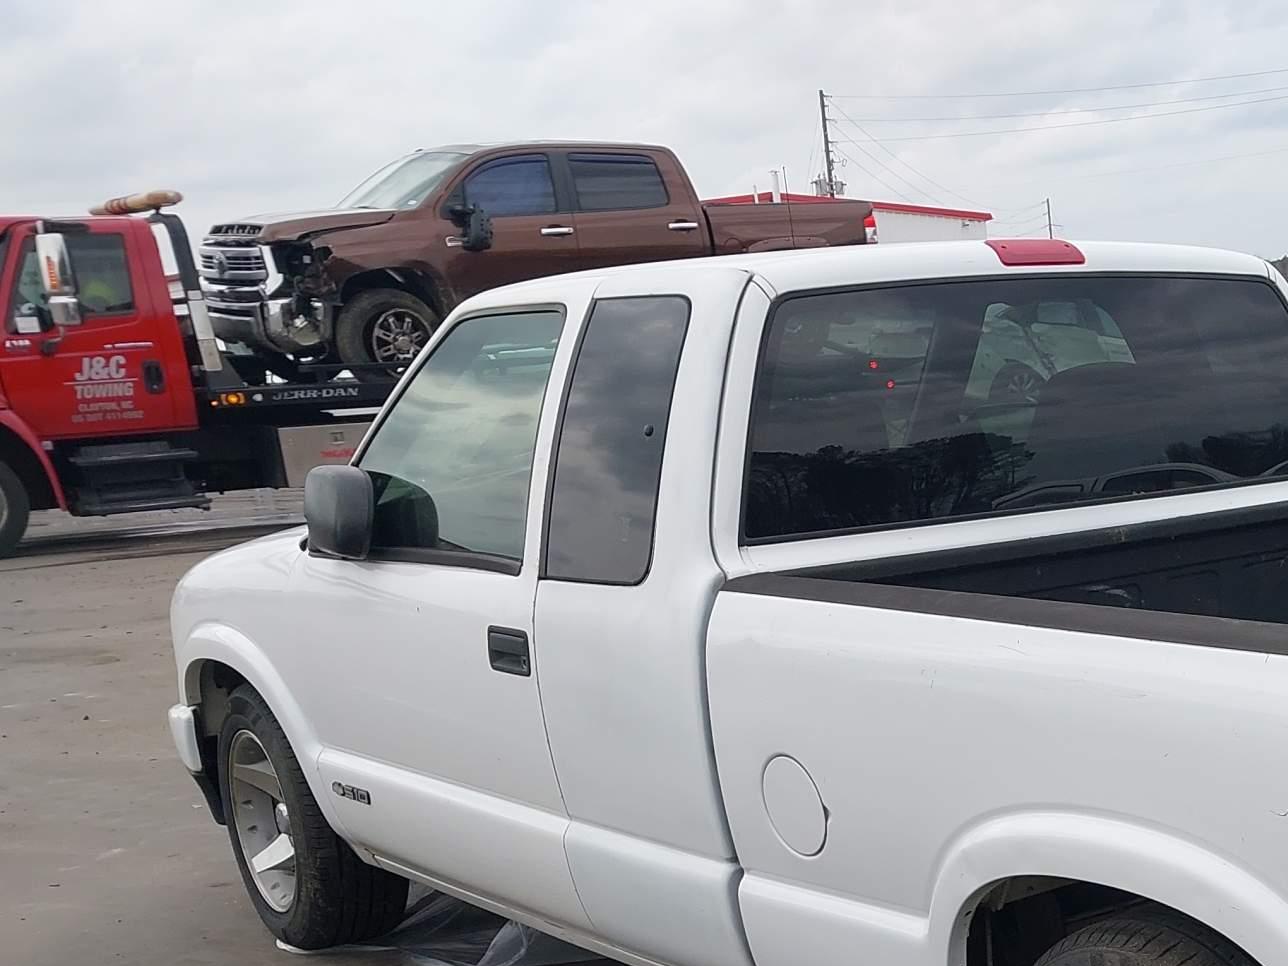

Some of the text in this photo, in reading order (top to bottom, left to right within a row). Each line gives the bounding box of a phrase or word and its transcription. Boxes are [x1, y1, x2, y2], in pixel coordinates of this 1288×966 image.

[74, 355, 127, 381] J&C
[74, 382, 134, 400] TOWING
[272, 387, 359, 401] JERR-DAN
[344, 785, 371, 805] S10
